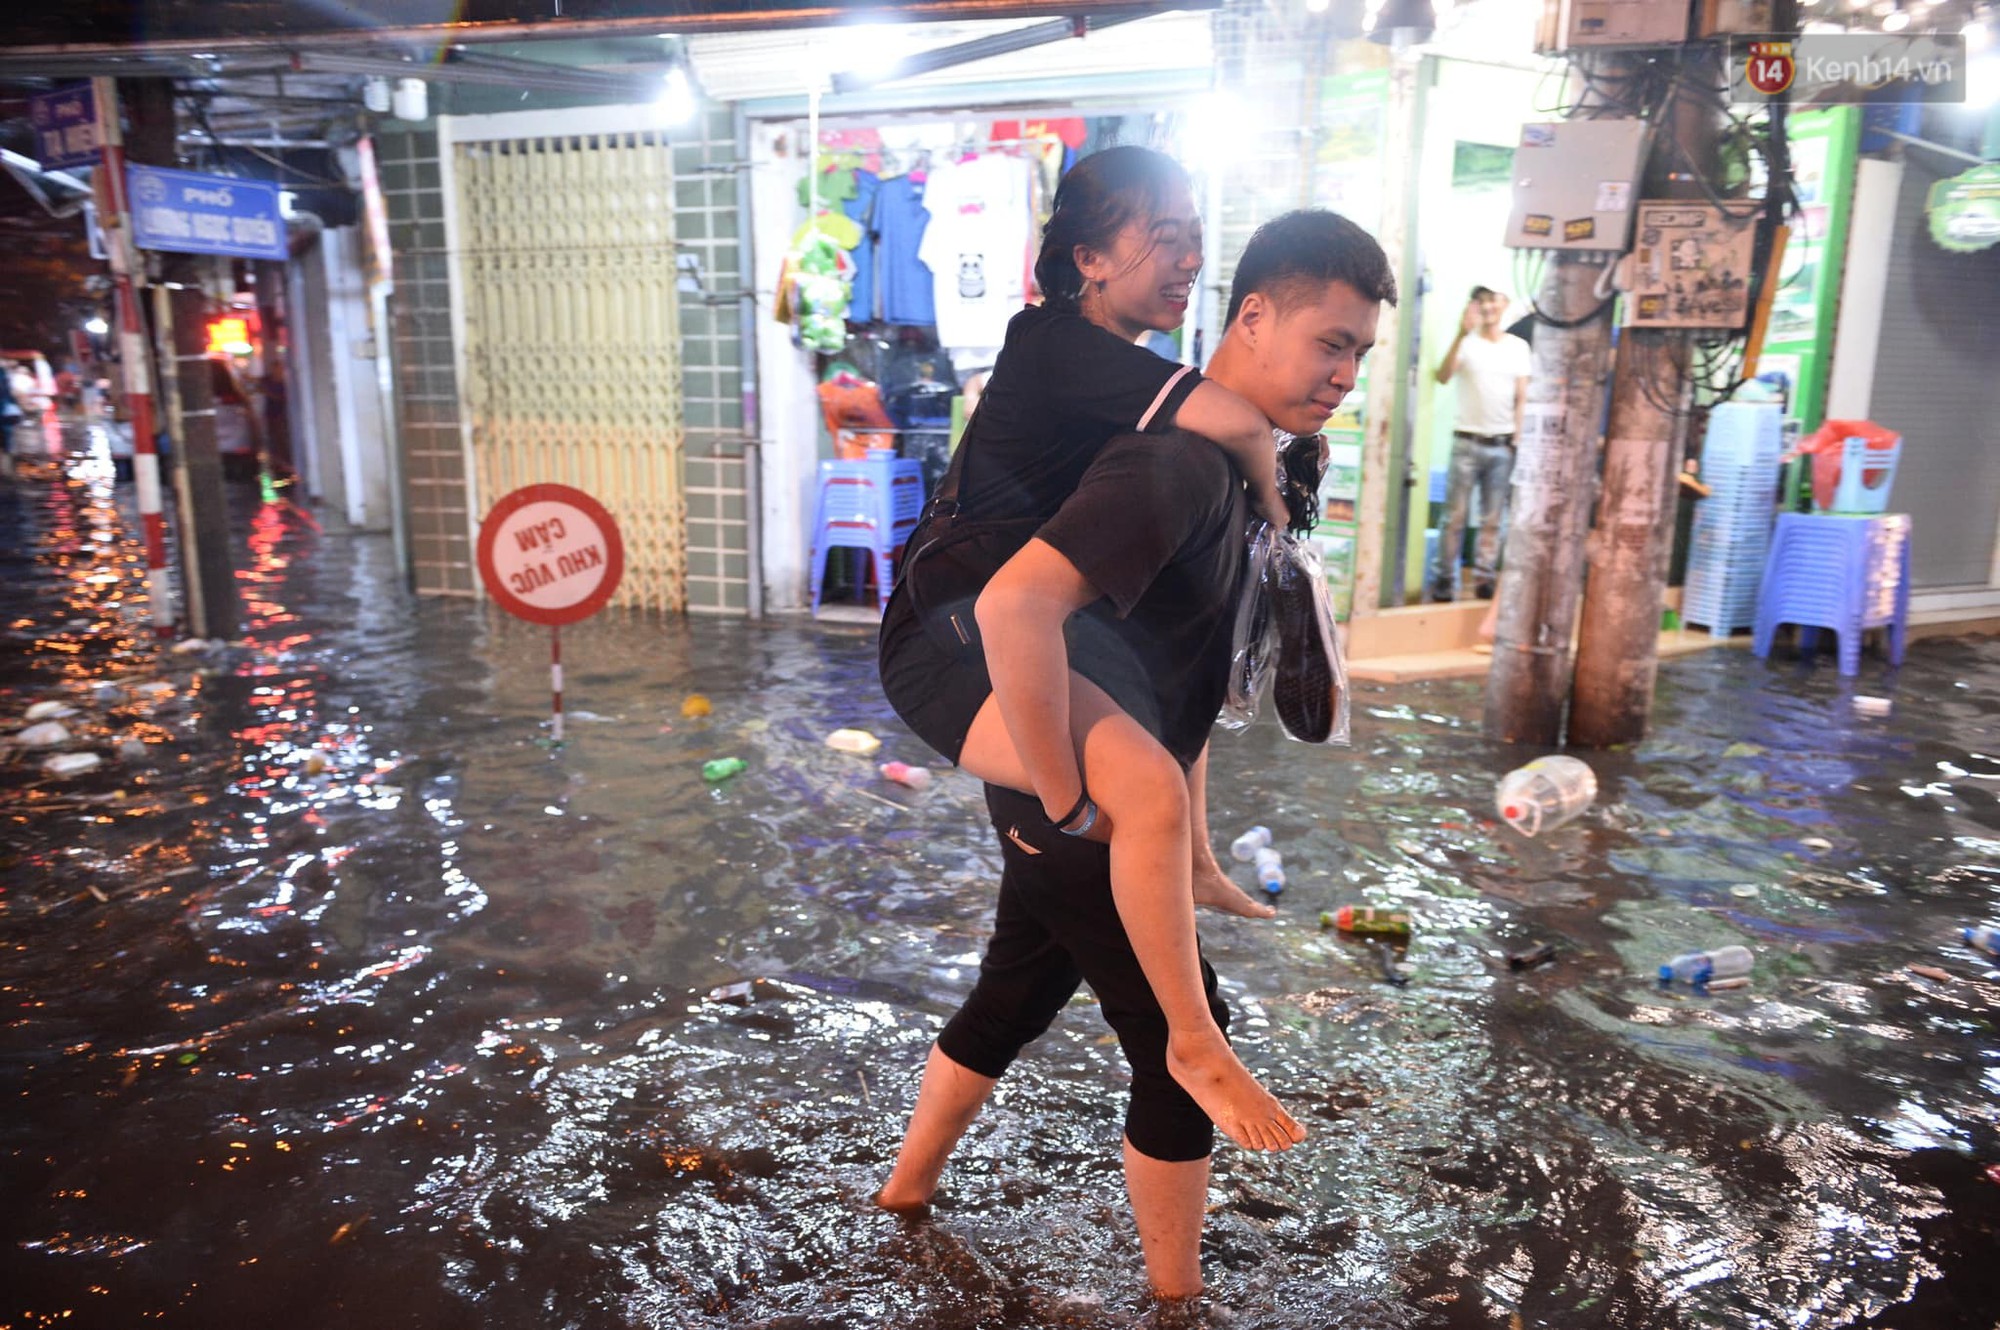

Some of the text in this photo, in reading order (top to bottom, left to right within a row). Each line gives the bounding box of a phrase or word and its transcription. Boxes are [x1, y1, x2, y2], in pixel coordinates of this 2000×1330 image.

[183, 186, 235, 208] PHỐ
[510, 544, 602, 595] KHU VỰC
